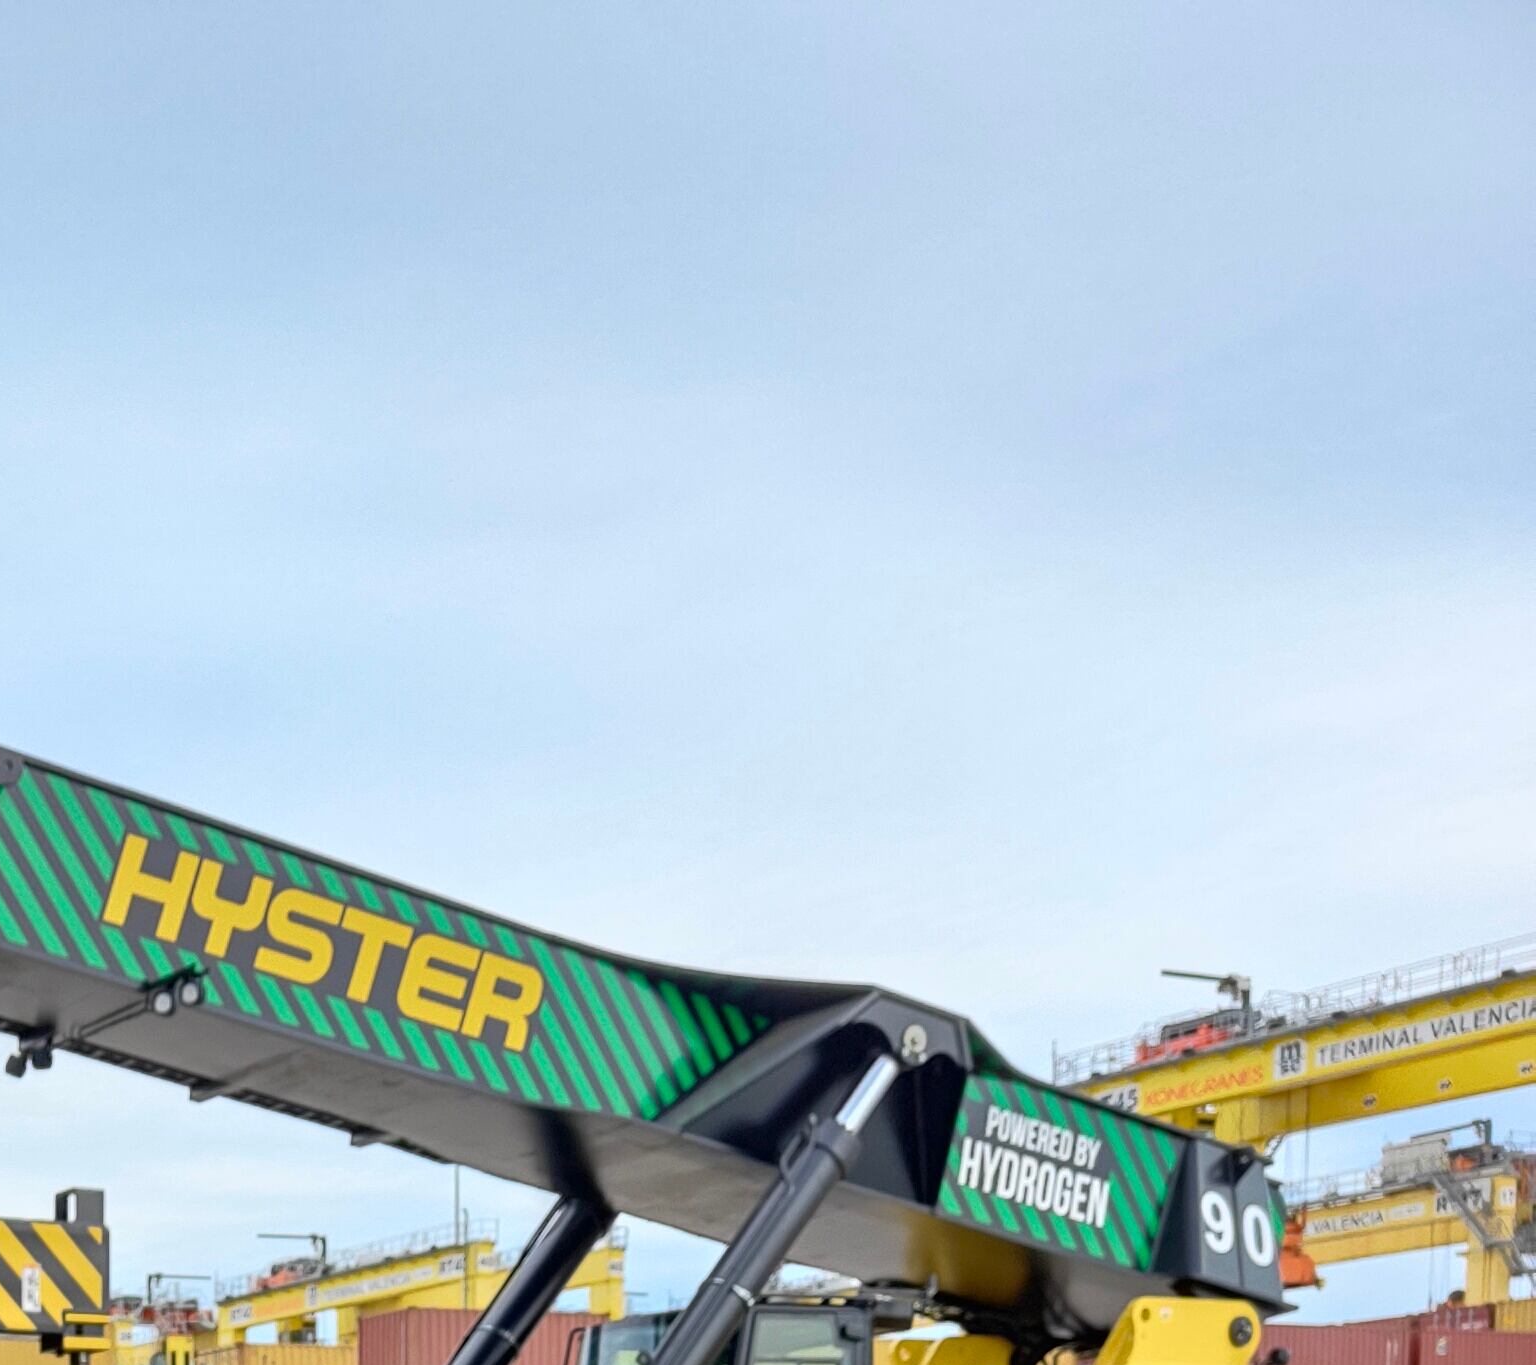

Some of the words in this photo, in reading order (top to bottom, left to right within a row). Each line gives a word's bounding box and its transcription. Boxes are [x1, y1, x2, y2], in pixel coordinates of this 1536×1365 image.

[101, 833, 545, 1053] HYSTER
[1318, 1028, 1425, 1065] TERMINAL
[1144, 1065, 1264, 1107] KONECRANES
[985, 1105, 1074, 1155] POWERED
[1073, 1138, 1102, 1168] BY
[958, 1136, 1111, 1228] HYDROGEN
[1201, 1190, 1274, 1268] 90
